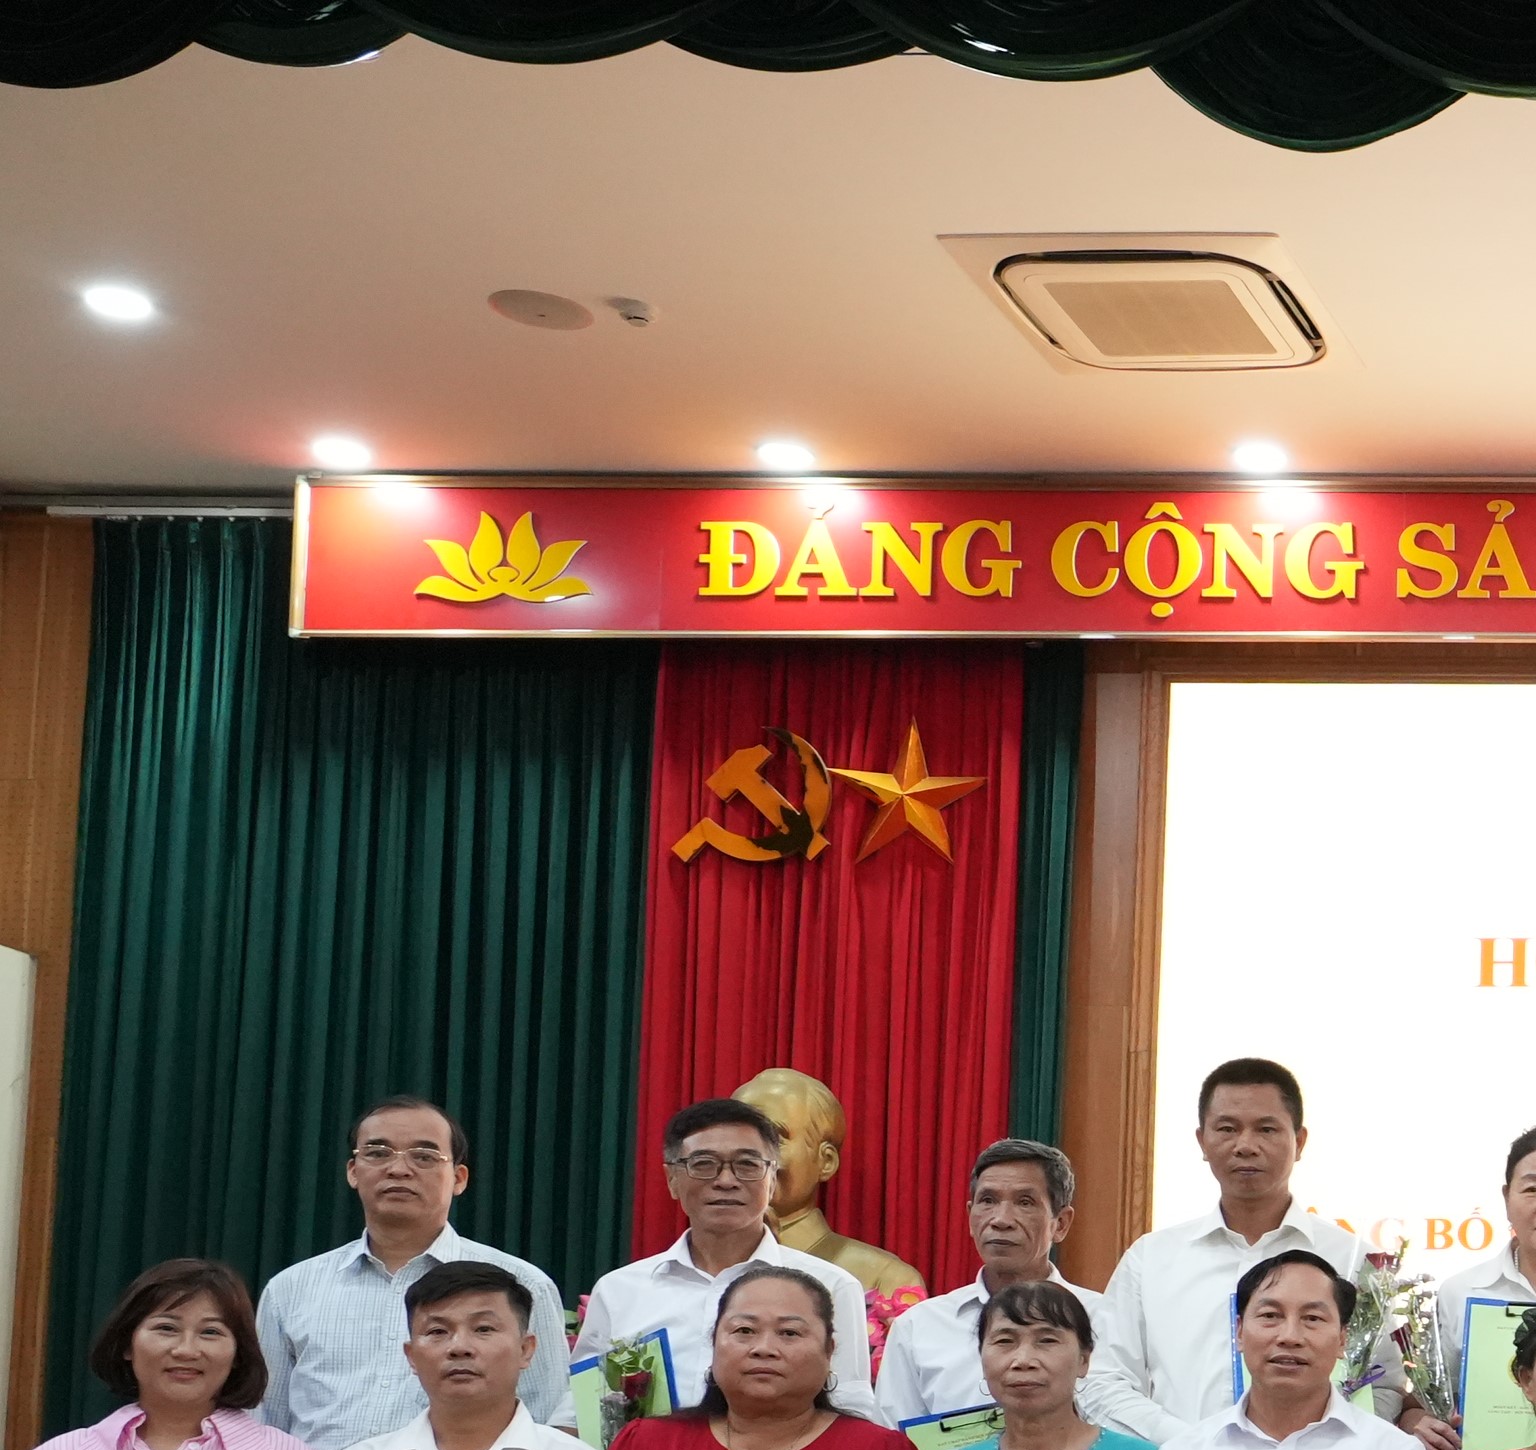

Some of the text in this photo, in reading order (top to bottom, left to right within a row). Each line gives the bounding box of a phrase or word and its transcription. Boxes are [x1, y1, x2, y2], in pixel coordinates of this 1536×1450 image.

[697, 500, 1022, 599] ĐẢNG
[1050, 502, 1367, 618] CỘNG
[1424, 1206, 1495, 1250] BỐ
